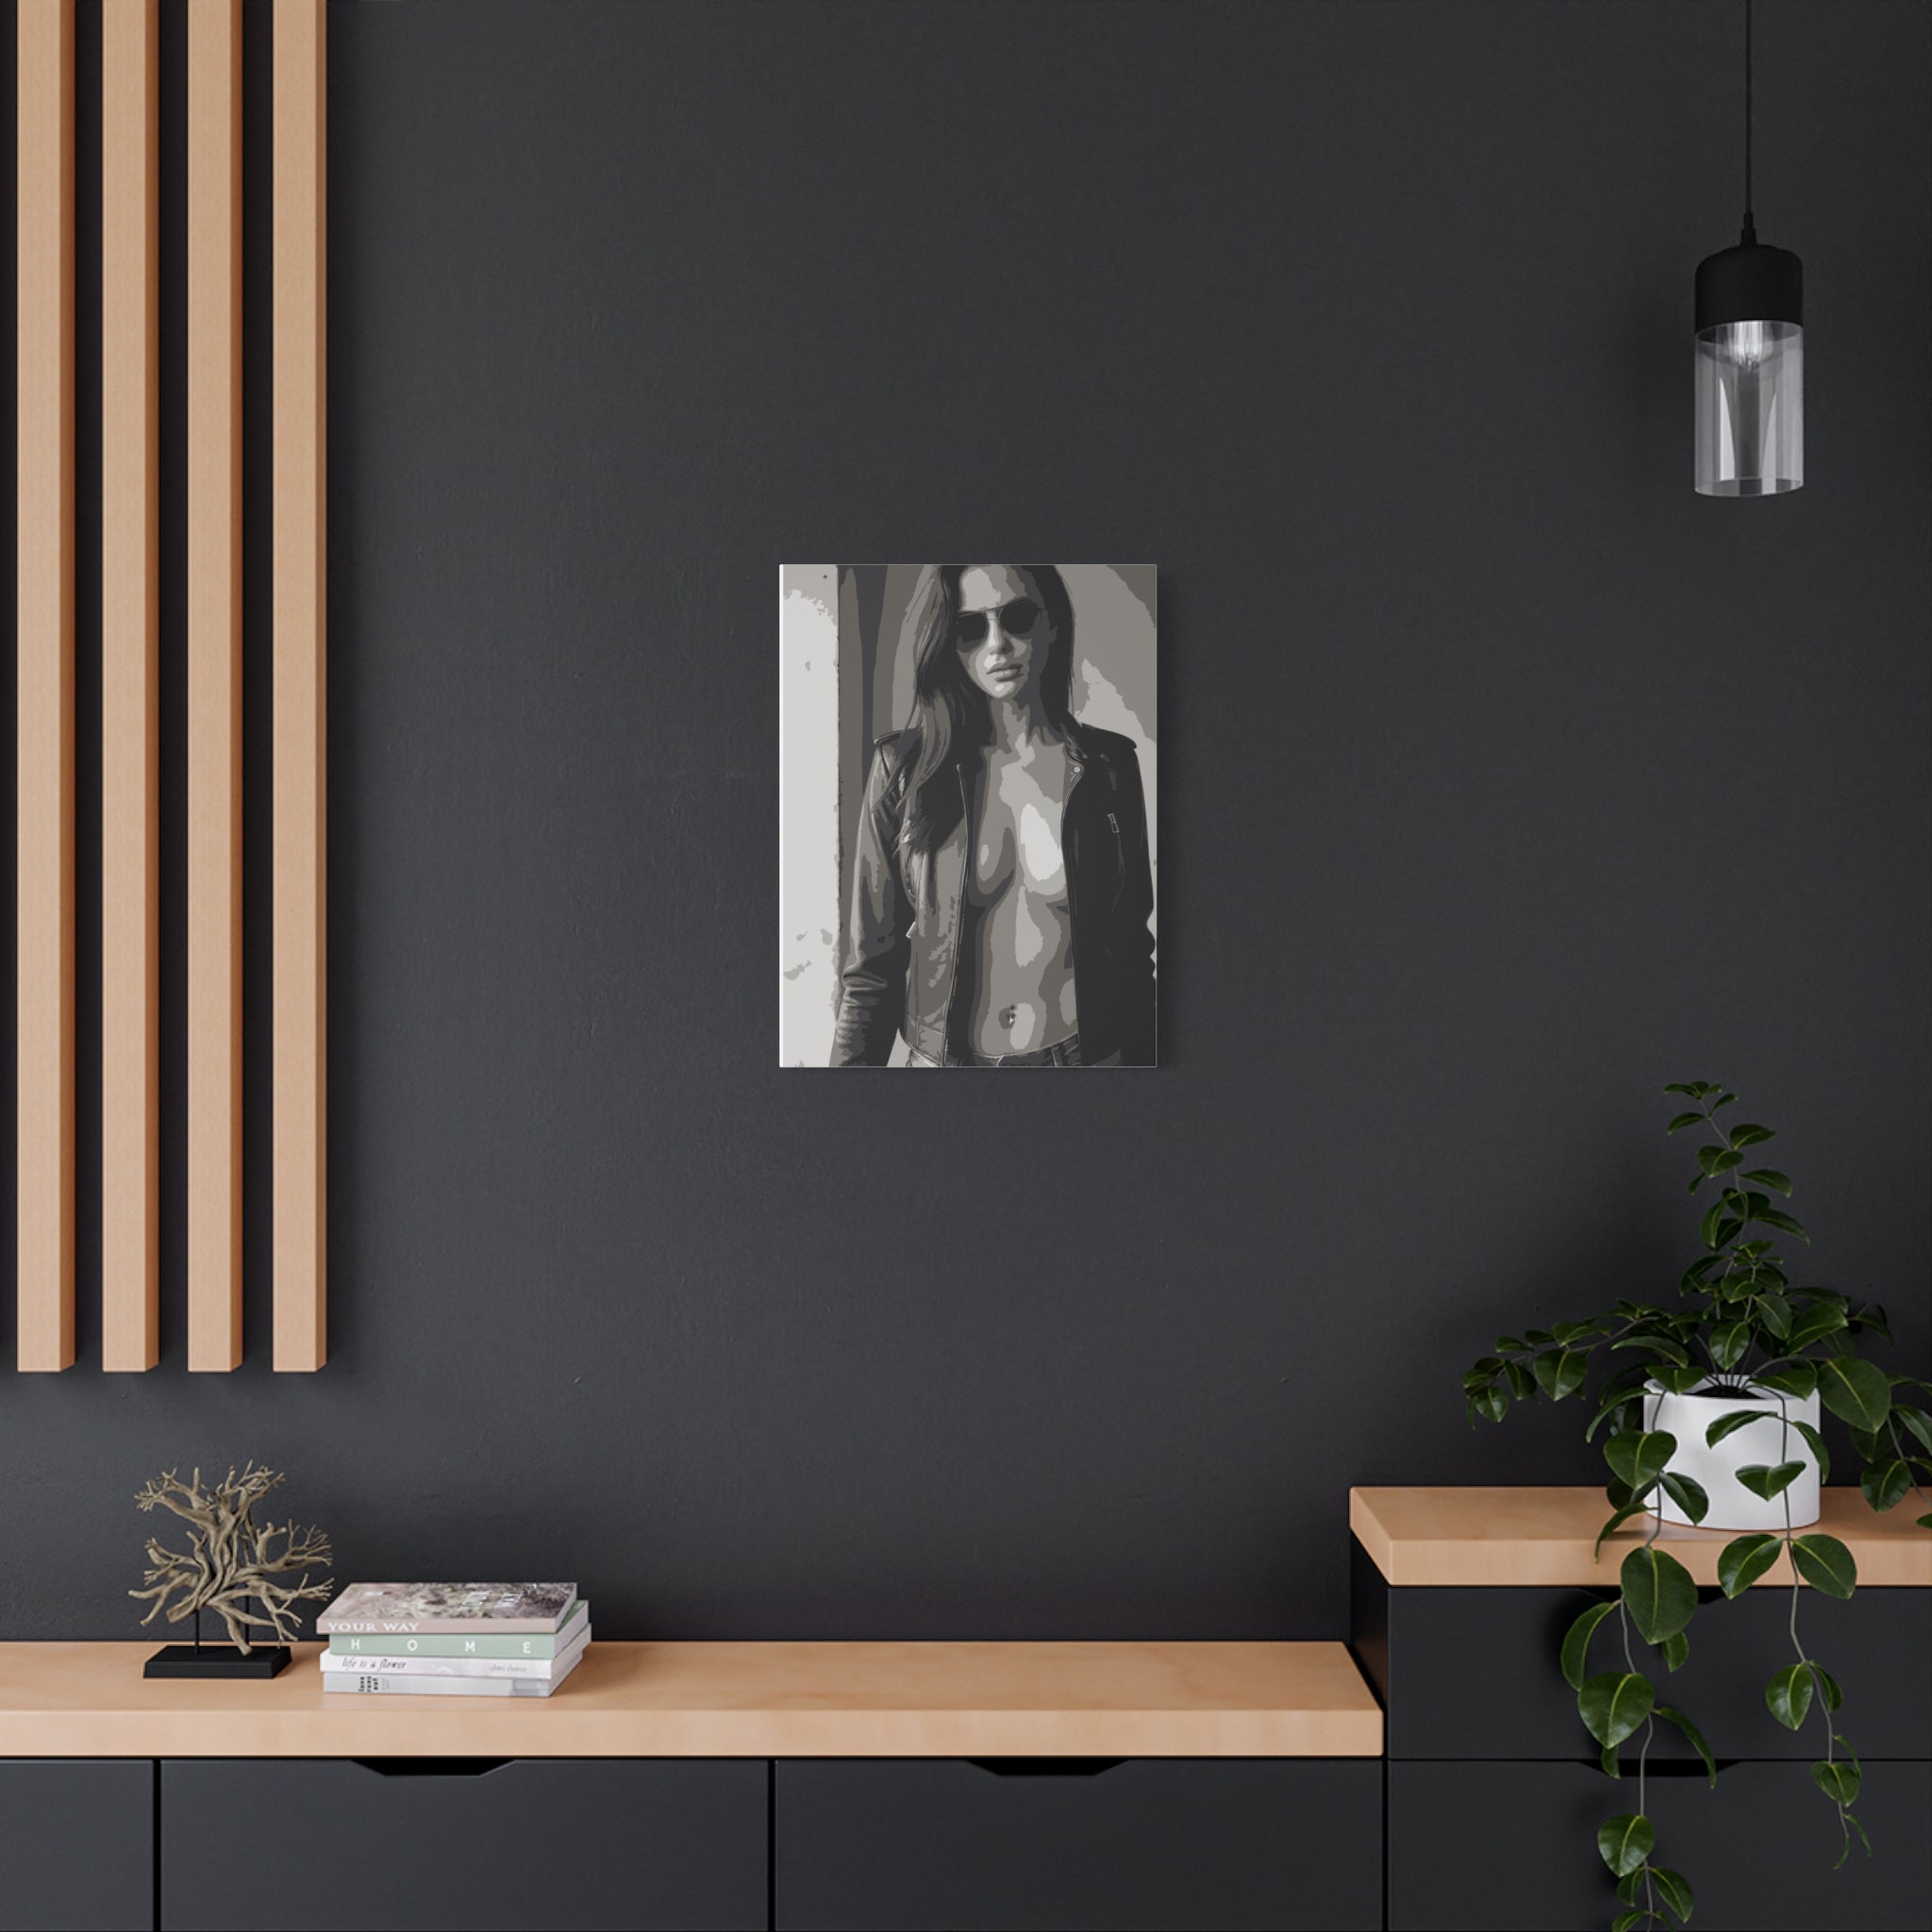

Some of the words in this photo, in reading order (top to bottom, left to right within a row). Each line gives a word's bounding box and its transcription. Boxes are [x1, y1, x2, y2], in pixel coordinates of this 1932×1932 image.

[328, 1622, 376, 1632] YOUR
[383, 1622, 419, 1632] WAY
[341, 1657, 357, 1670] life
[359, 1659, 367, 1668] is
[377, 1657, 407, 1672] flower
